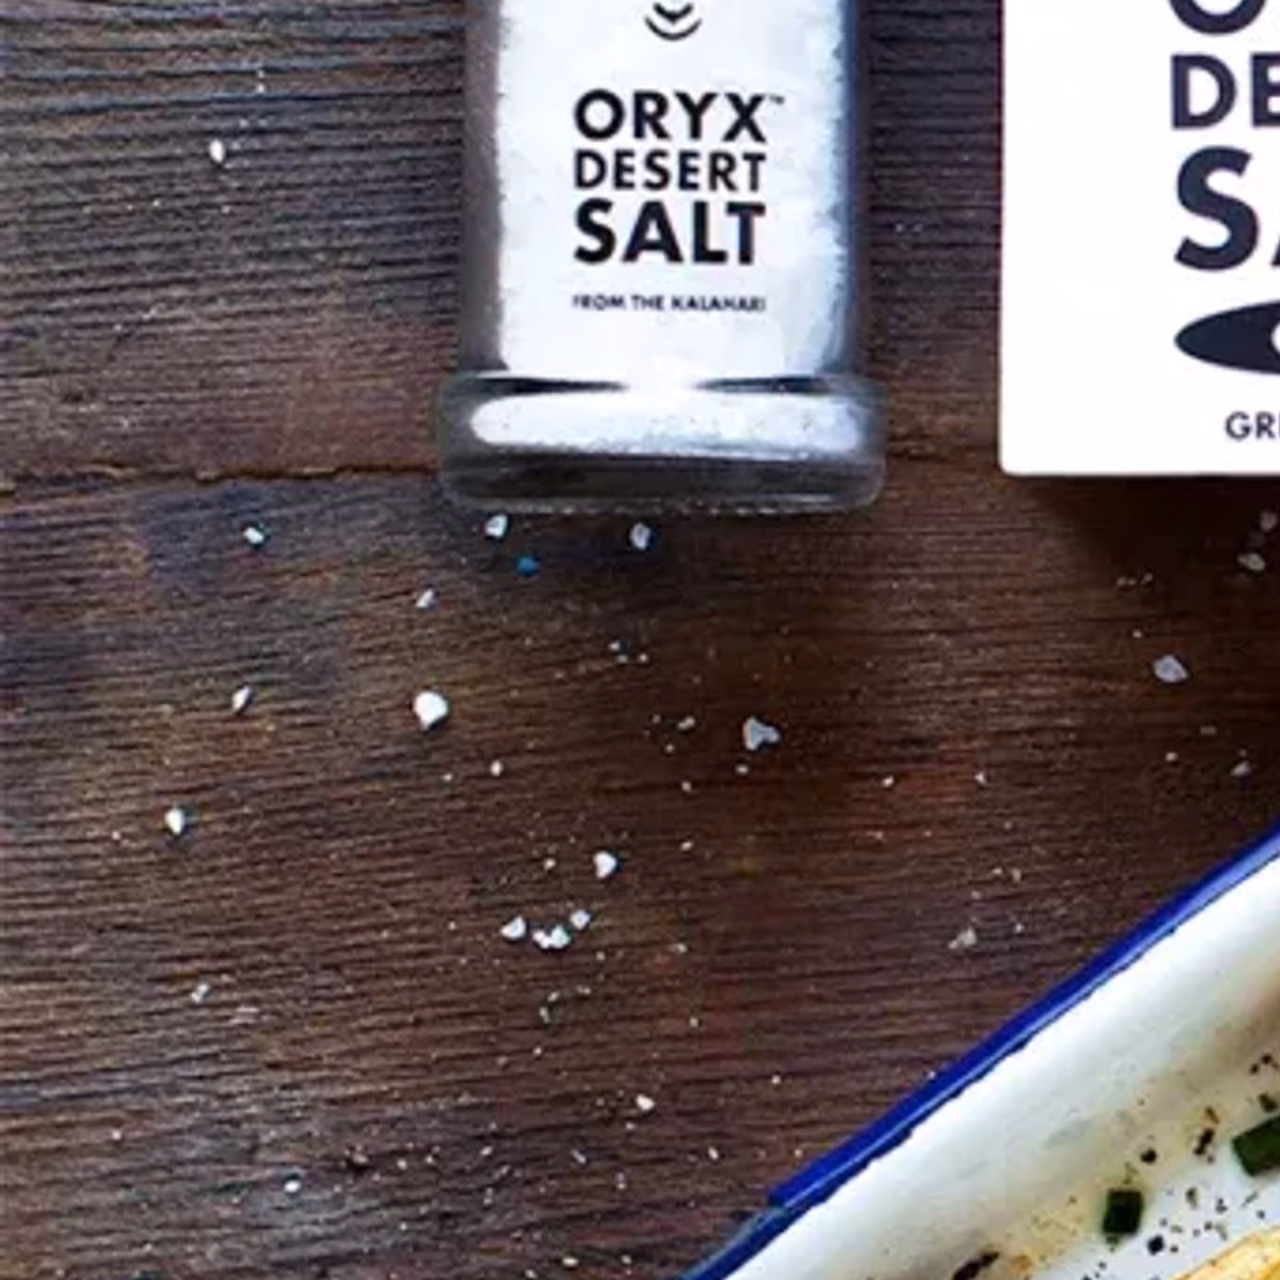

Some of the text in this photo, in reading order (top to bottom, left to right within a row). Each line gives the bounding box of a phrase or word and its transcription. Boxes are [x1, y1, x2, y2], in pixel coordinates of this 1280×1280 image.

[573, 88, 767, 143] ORYX
[573, 148, 767, 192] DESERT
[572, 197, 767, 266] SALT
[572, 293, 624, 310] FROM
[631, 294, 665, 311] THE
